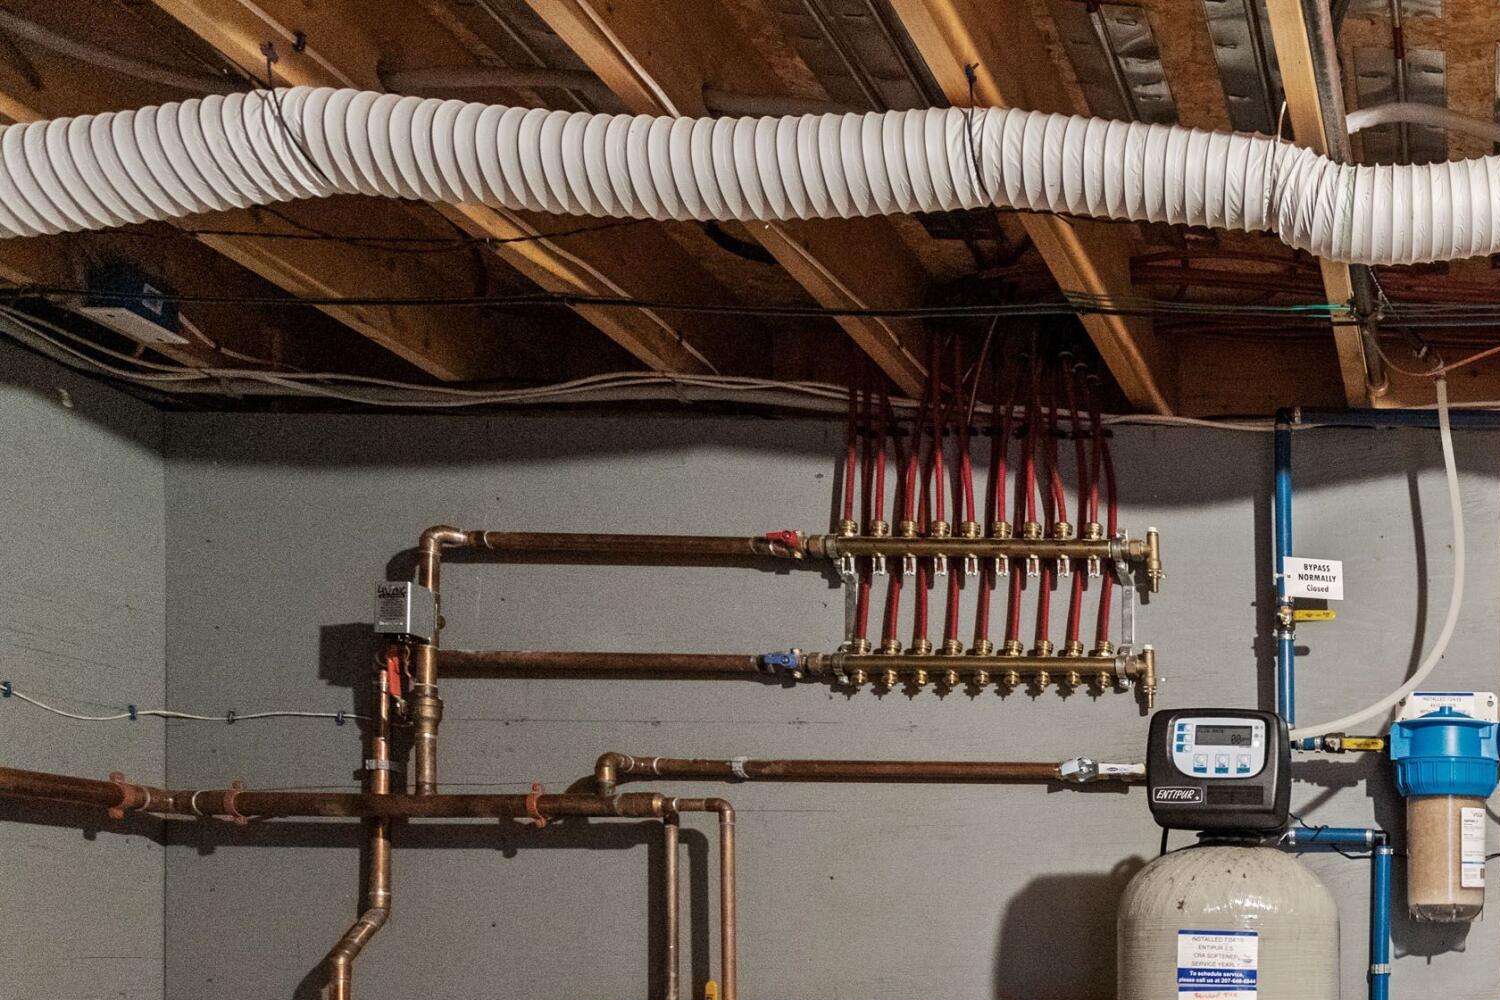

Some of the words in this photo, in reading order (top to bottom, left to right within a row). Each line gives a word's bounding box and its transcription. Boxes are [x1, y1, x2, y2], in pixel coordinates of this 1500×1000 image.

[1303, 563, 1331, 572] BYPASS
[1298, 573, 1337, 583] NORMALLY
[1306, 584, 1329, 593] Closed
[1156, 789, 1195, 800] ENTIPUR
[1214, 976, 1221, 984] at
